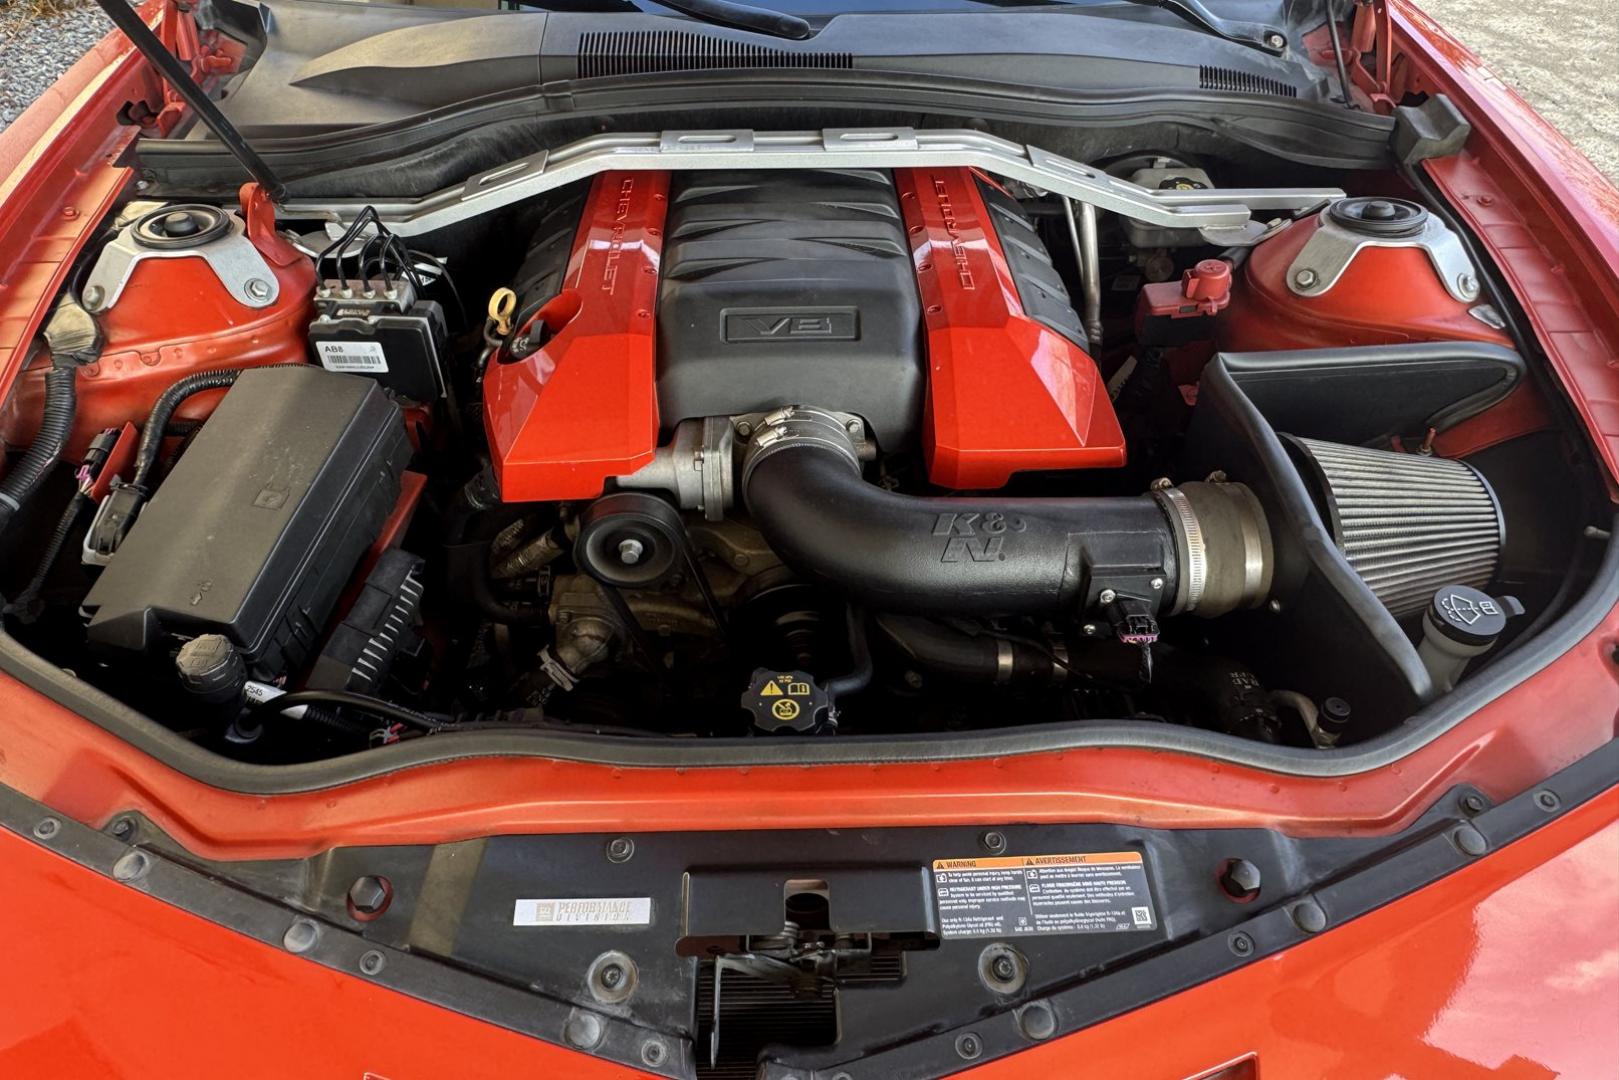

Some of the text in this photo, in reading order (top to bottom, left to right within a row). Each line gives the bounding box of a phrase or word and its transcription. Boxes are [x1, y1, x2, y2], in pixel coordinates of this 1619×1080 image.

[601, 178, 634, 296] CHEVROLET
[931, 175, 976, 290] CHEVROLET
[739, 316, 832, 335] V8
[946, 860, 977, 869] WARNING
[1035, 855, 1087, 865] AVERTISSEMENT
